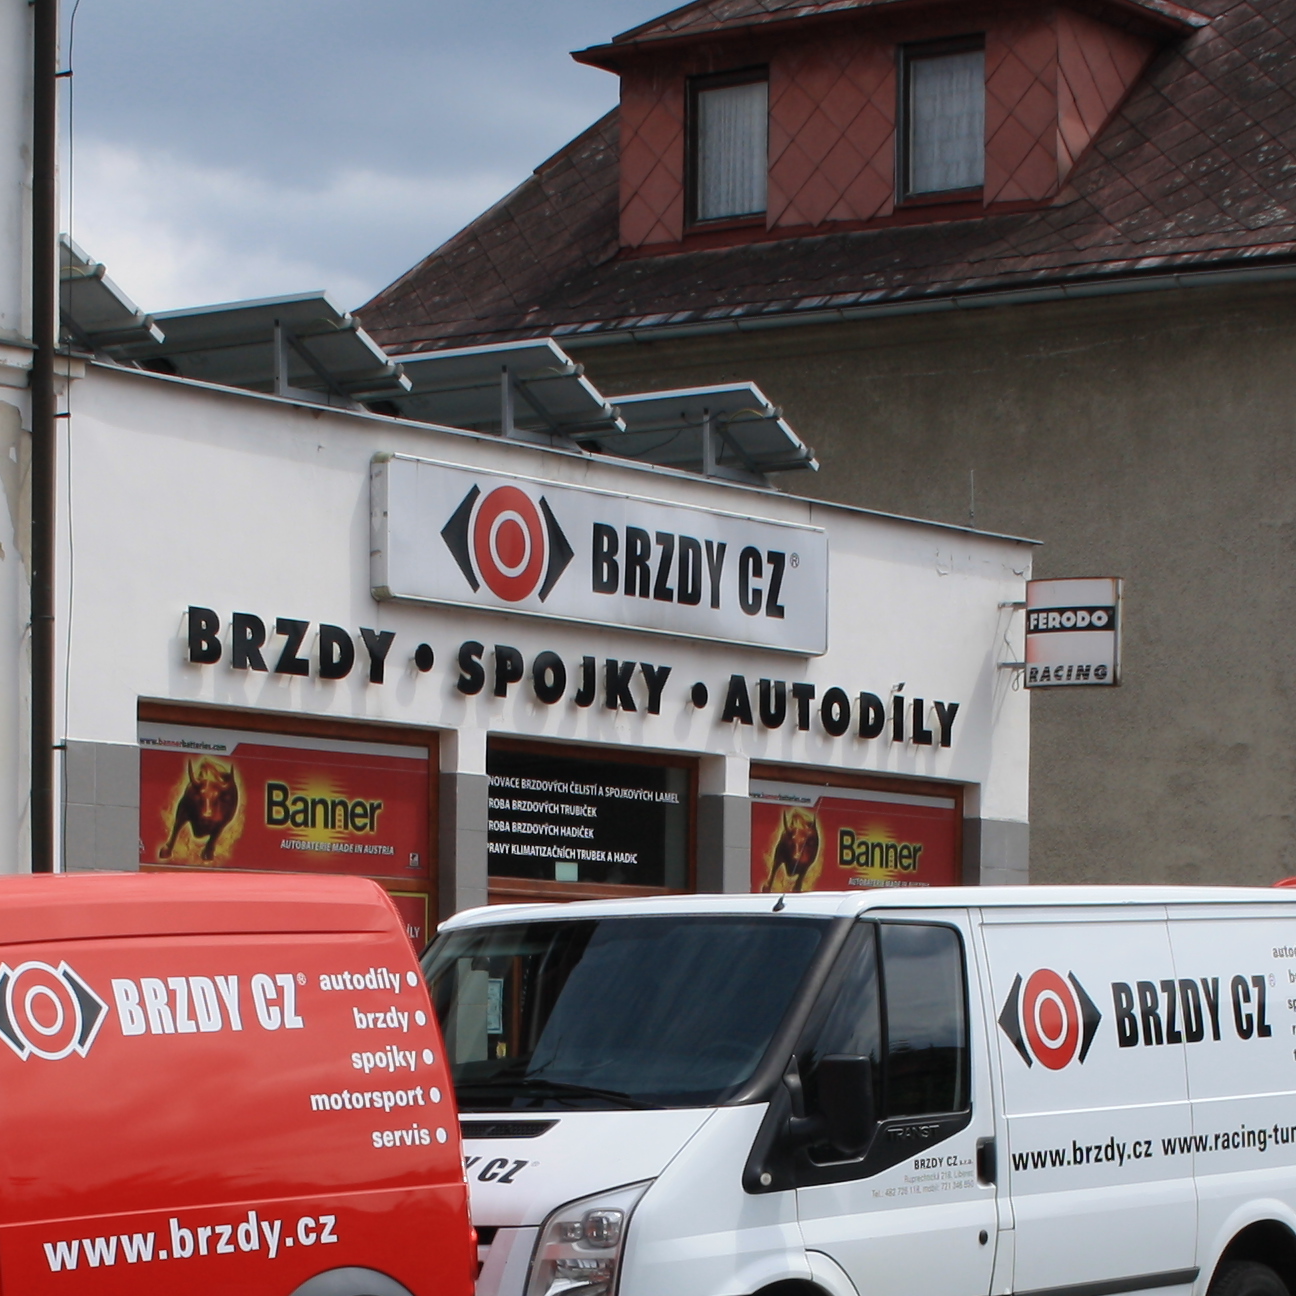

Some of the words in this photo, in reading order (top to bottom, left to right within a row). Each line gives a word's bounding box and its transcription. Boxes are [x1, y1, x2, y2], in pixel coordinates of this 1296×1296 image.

[592, 522, 727, 609] BRZDY
[738, 545, 786, 619] CZ
[1029, 610, 1109, 630] FERODO
[187, 605, 396, 685] BRZDY
[456, 640, 672, 716] SPOJKY
[721, 673, 960, 748] AUTODÍLY
[1028, 664, 1108, 683] RACING
[521, 779, 568, 793] BRZDOVÝCH
[598, 786, 604, 796] A
[605, 787, 653, 802] SPOJKOVÝCH
[655, 791, 680, 804] LAMEL
[265, 781, 383, 834] Banner
[512, 799, 559, 814] BRZDOVÝCH
[560, 804, 597, 817] TRUBIČEK
[512, 821, 559, 836] BRZDOVÝCH
[560, 826, 594, 839] HADIČEK
[280, 840, 331, 852] AUTOBATERIE
[332, 843, 353, 853] MADE
[354, 845, 363, 853] IN
[363, 845, 394, 855] AUSTRIA
[511, 844, 575, 859] KLIMATIZAČNÍCH
[577, 851, 606, 862] TRUBEK
[607, 853, 613, 863] A
[838, 828, 922, 872] Banner
[319, 968, 400, 993] autodíly
[111, 975, 242, 1036] BRZDY
[251, 973, 304, 1030] CZ
[1111, 977, 1221, 1048] BRZDY
[1231, 974, 1272, 1040] CZ
[353, 1006, 408, 1032] brzdy
[351, 1045, 416, 1073] spojky
[310, 1086, 425, 1112] motorsport
[372, 1123, 430, 1148] servis
[914, 1157, 944, 1170] BRZDY
[947, 1155, 958, 1167] CZ
[1012, 1136, 1152, 1171] www.brzdy.cz
[477, 1158, 529, 1184] CZ
[43, 1210, 338, 1272] www.brzdy.cz
